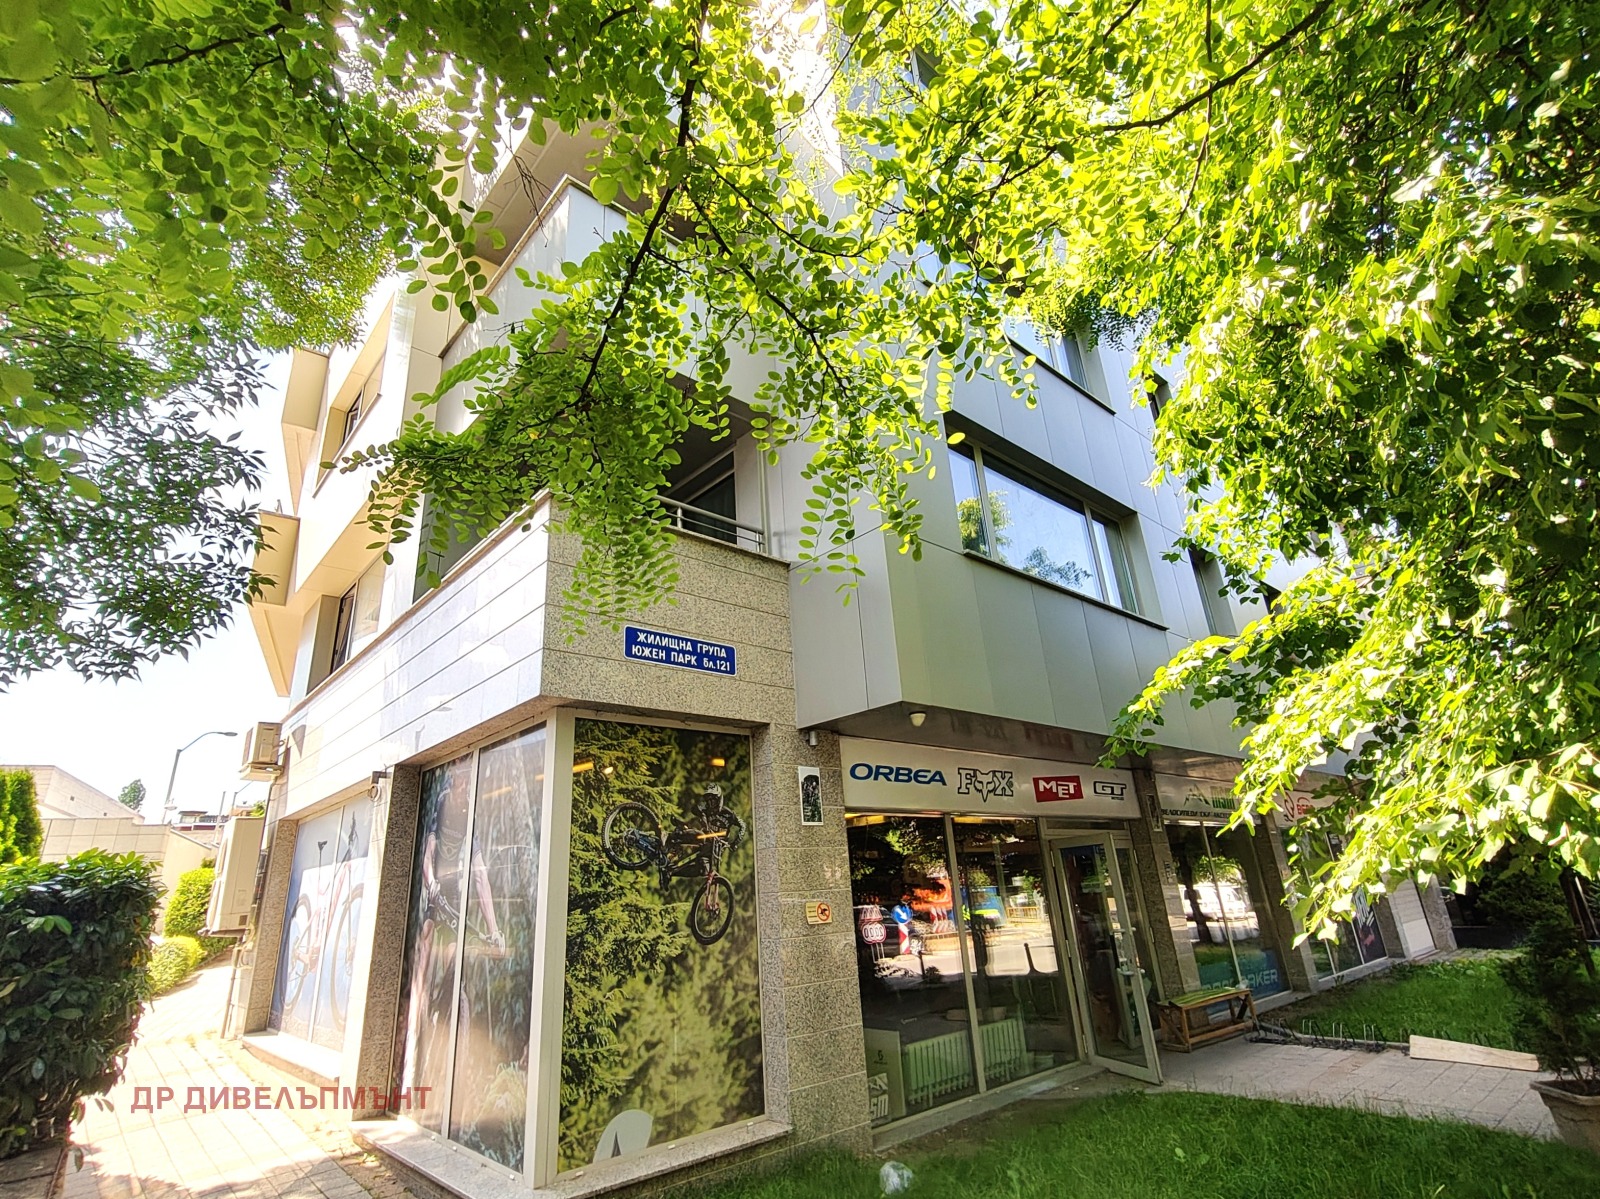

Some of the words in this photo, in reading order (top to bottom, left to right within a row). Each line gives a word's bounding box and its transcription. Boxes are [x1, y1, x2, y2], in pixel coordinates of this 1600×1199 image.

[631, 644, 666, 661] ЮЖЕН
[671, 651, 698, 666] ПАРК
[637, 631, 693, 652] ЖИЛИЩНА
[697, 643, 727, 658] ГРУПА
[849, 762, 948, 787] ORBEA
[1038, 779, 1078, 798] MET
[1093, 780, 1127, 797] GT
